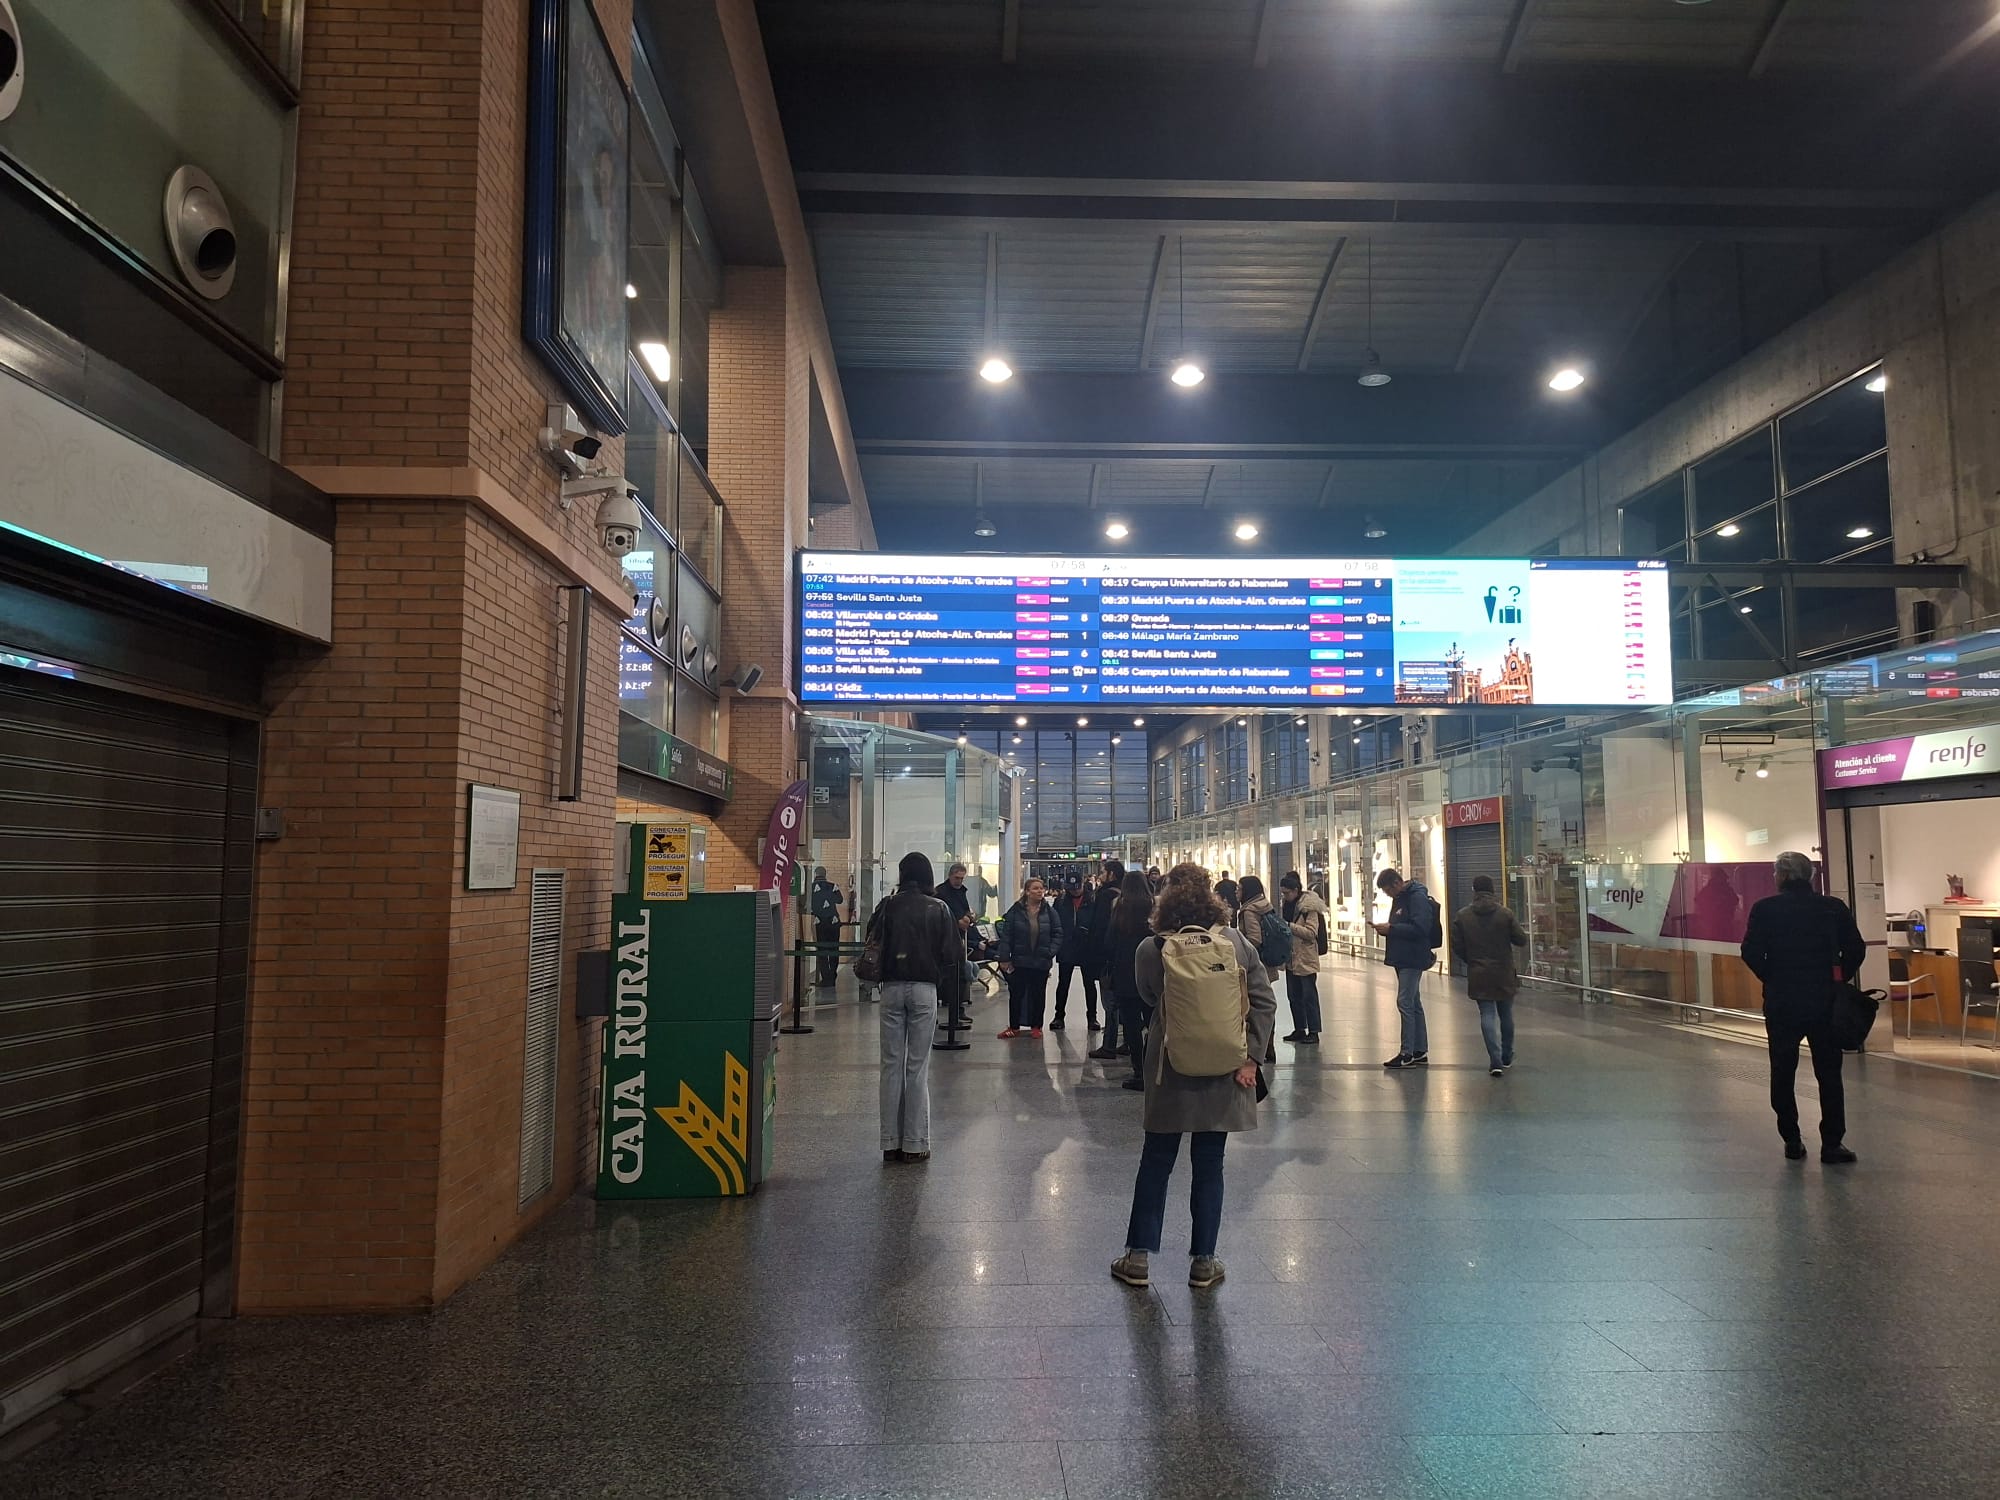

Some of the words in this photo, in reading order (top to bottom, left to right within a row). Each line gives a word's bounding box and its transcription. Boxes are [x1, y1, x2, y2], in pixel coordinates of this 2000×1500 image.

[1050, 560, 1086, 570] 07:58
[1344, 562, 1379, 570] 07:58
[806, 574, 834, 582] 07:42
[836, 575, 868, 584] Madrid
[870, 576, 901, 584] Puerta
[902, 576, 914, 584] de
[915, 576, 974, 585] Atocha-Alm.
[974, 576, 1013, 586] Grandes
[1081, 577, 1087, 586] 1
[1102, 578, 1129, 587] 08:19
[1131, 578, 1168, 588] Campus
[1170, 578, 1227, 588] Universitario
[1228, 579, 1240, 588] de
[1242, 579, 1288, 588] Rabanales
[868, 594, 895, 602] Santa
[896, 594, 922, 602] Justa
[1102, 596, 1130, 605] 08:20
[1131, 596, 1164, 605] Madrid
[1164, 596, 1195, 605] Puerta
[1196, 597, 1208, 605] de
[1210, 596, 1267, 606] Atocha-Alm.
[1268, 597, 1306, 606] Grandes
[805, 610, 834, 619] 08:02
[836, 611, 883, 620] Villarrubia
[884, 612, 897, 620] de
[898, 612, 938, 620] Córdoba
[1102, 614, 1129, 622] 08:29
[1131, 614, 1170, 623] Granada
[805, 629, 834, 637] 08:02
[836, 629, 868, 638] Madrid
[870, 630, 900, 638] Puerta
[902, 630, 914, 638] de
[914, 630, 973, 639] Atocha-Alm.
[974, 631, 1012, 640] Grandes
[1081, 631, 1088, 640] 1
[1131, 632, 1164, 642] Málaga
[1166, 632, 1192, 640] María
[1194, 632, 1240, 641] Zambrano
[805, 647, 834, 655] 08:05
[836, 647, 856, 656] Villa
[858, 647, 872, 656] del
[874, 647, 890, 656] Río
[1080, 648, 1088, 658] 6
[1102, 650, 1130, 658] 08:42
[1132, 650, 1162, 658] Sevilla
[1163, 650, 1190, 658] Santa
[1190, 650, 1217, 658] Justa
[804, 665, 833, 673] 08:13
[836, 665, 866, 674] Sevilla
[868, 666, 895, 674] Santa
[896, 666, 922, 674] Justa
[1102, 668, 1130, 676] 08:45
[1132, 668, 1169, 678] Campus
[1170, 668, 1228, 676] Universitario
[1228, 668, 1241, 676] de
[1242, 668, 1290, 677] Rabanales
[804, 683, 833, 692] 08:14
[834, 683, 862, 692] Cádiz
[1080, 684, 1088, 694] 7
[1102, 686, 1130, 694] 08:54
[1132, 686, 1164, 694] Madrid
[1165, 686, 1195, 694] Puerta
[1196, 686, 1209, 694] de
[1210, 686, 1268, 695] Atocha-Alm.
[1268, 686, 1308, 695] Grandes
[1929, 735, 1987, 768] renfe
[1834, 756, 1863, 768] Atención
[1864, 755, 1871, 765] al
[1872, 752, 1896, 764] cliente
[1834, 768, 1858, 778] Customer
[1858, 766, 1877, 776] Service
[1459, 802, 1482, 822] CANDY
[772, 834, 789, 891] enfe
[1606, 884, 1644, 911] renfe
[614, 908, 650, 1060] RURAL
[612, 1070, 646, 1184] CAJA
